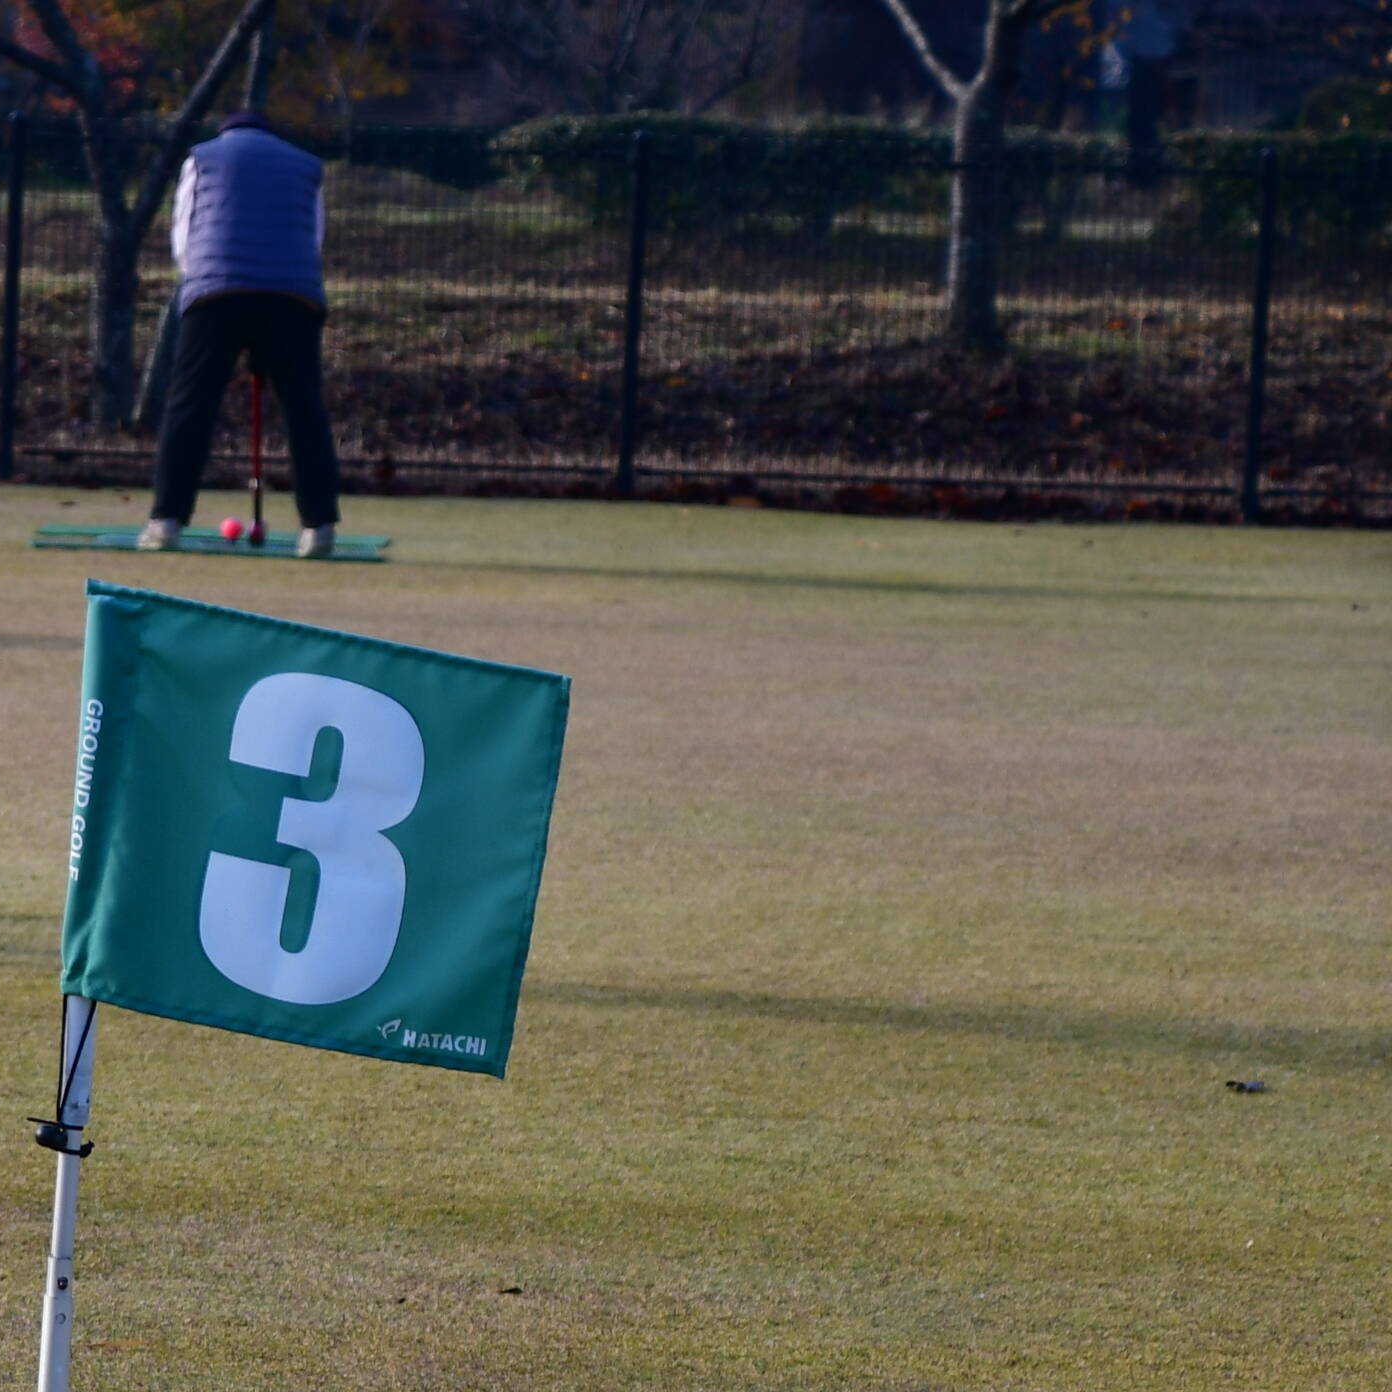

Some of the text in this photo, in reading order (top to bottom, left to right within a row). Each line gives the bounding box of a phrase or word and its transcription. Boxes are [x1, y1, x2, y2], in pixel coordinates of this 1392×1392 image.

[69, 699, 103, 881] GROUND GOLF
[199, 672, 425, 1005] 3
[402, 1029, 487, 1056] HATACHI
